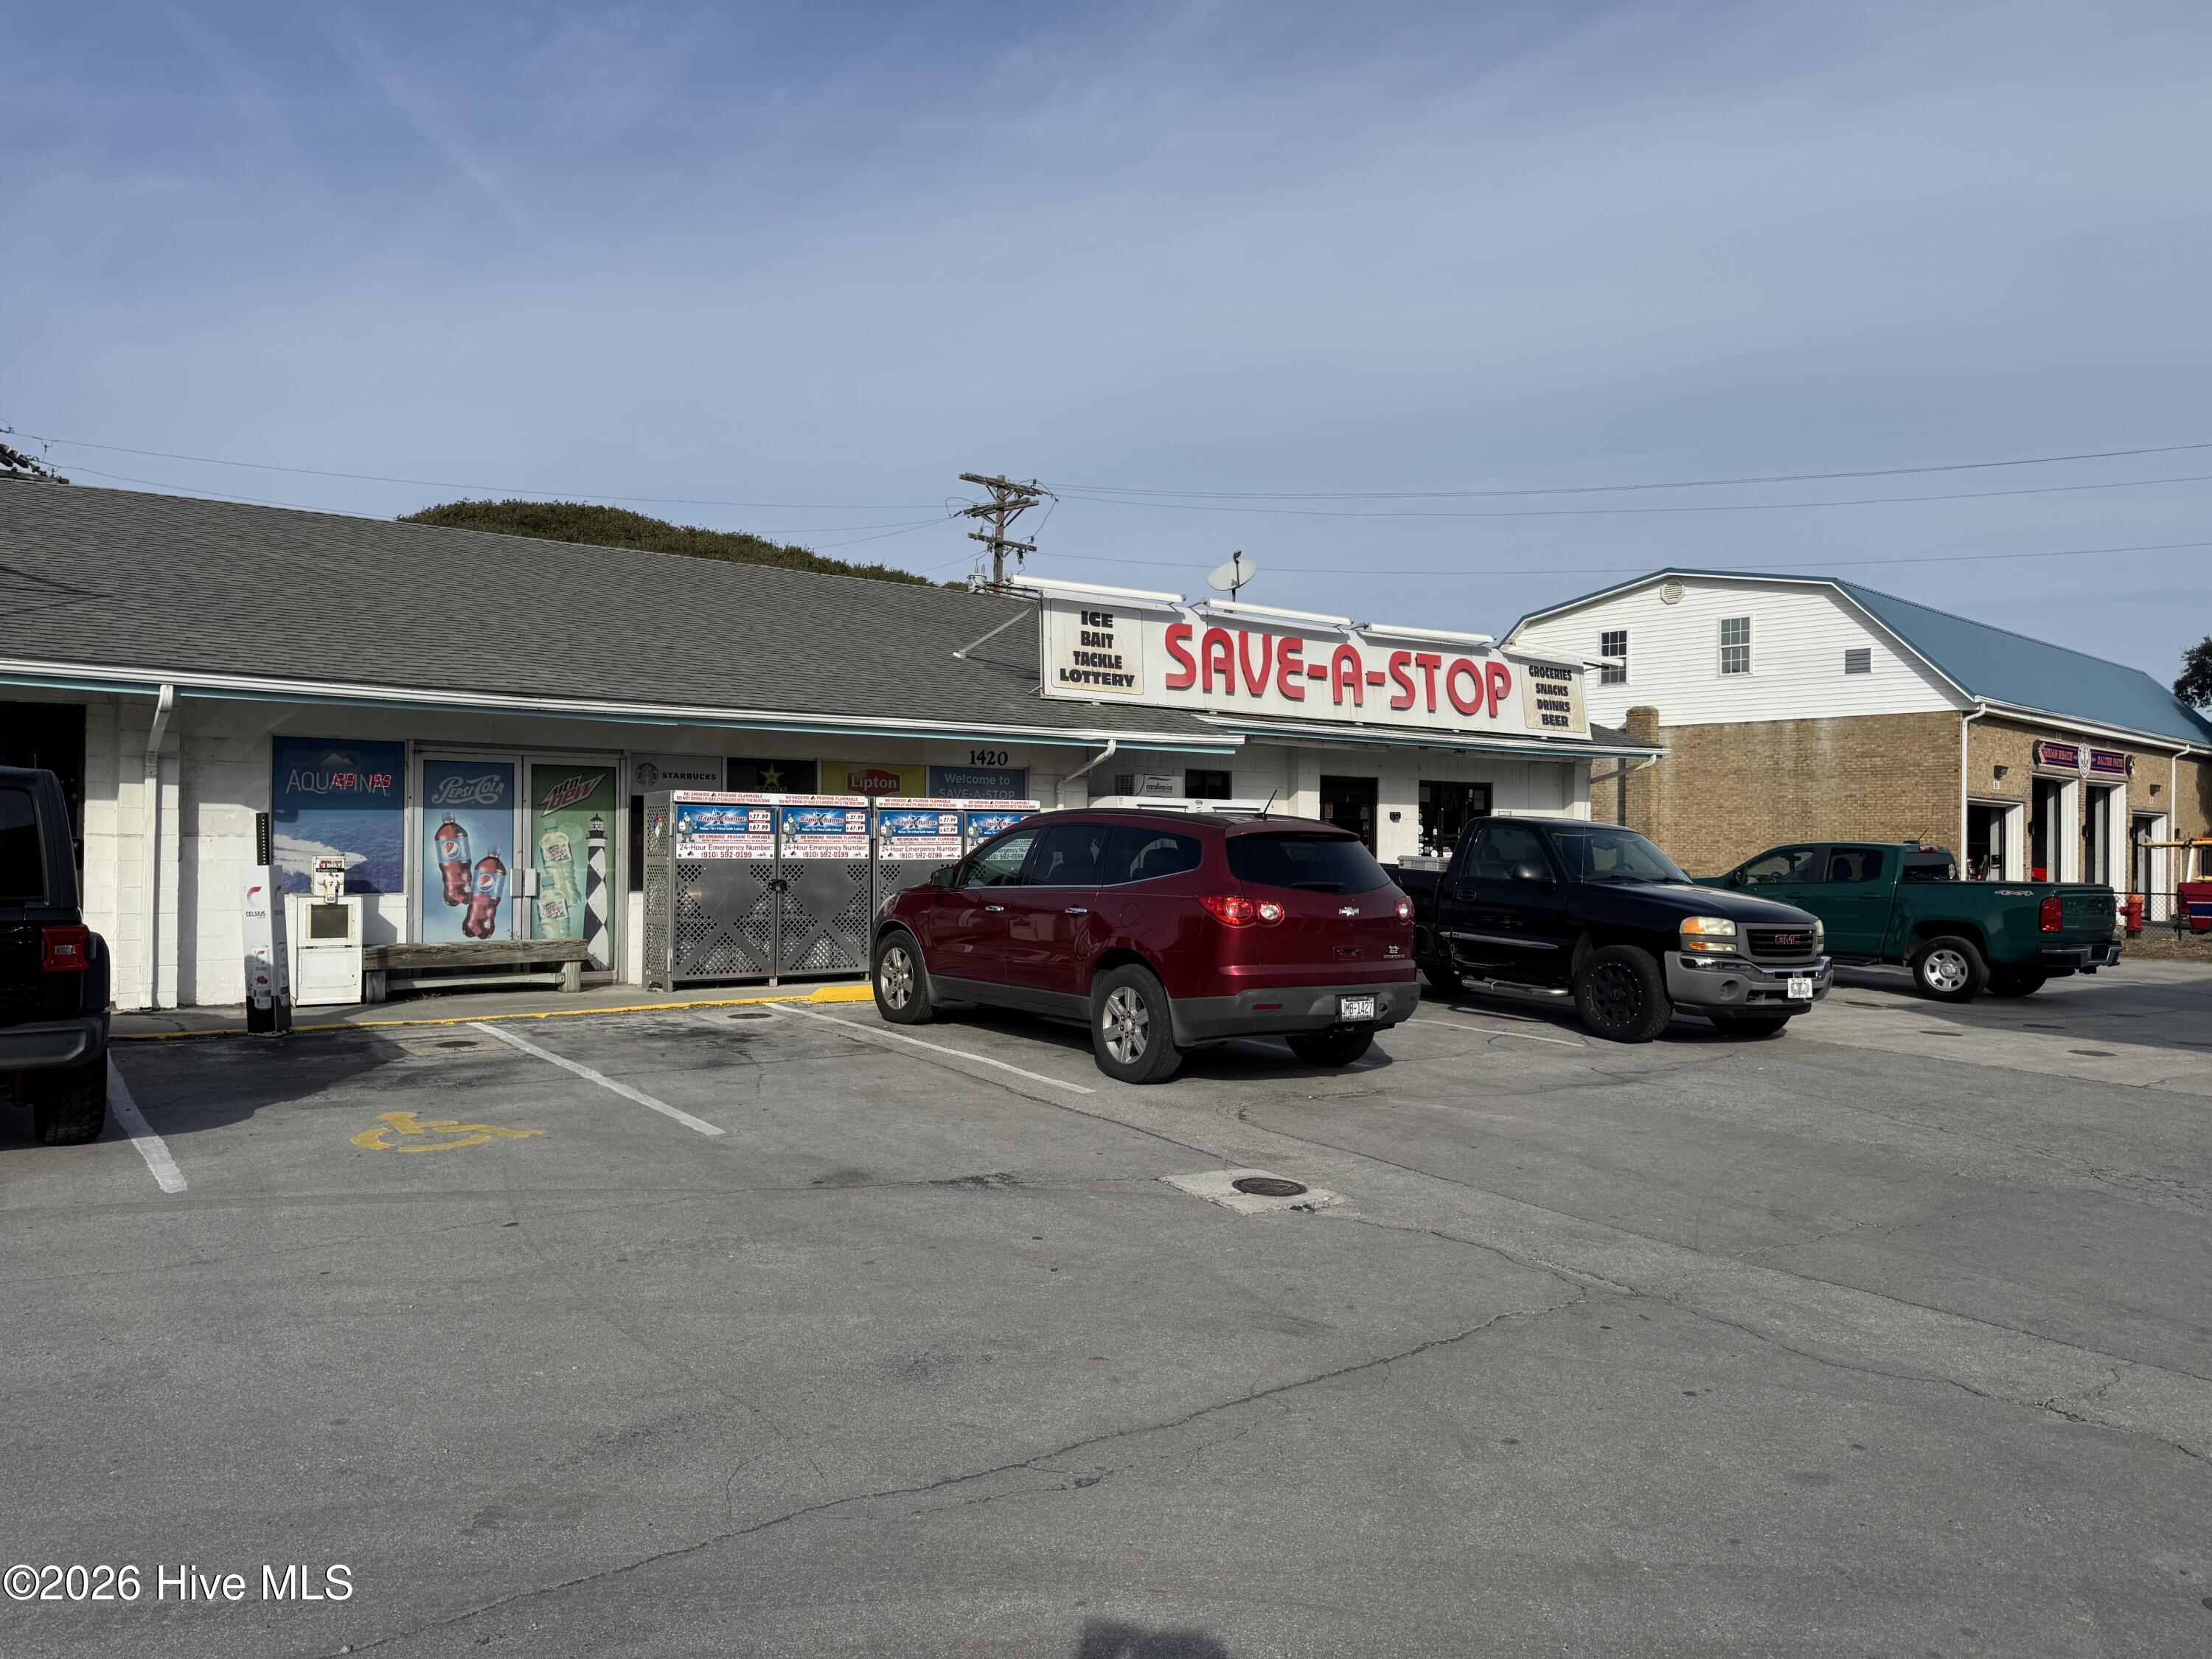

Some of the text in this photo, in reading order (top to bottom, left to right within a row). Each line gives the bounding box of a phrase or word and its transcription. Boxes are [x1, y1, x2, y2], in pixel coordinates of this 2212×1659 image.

[1081, 611, 1113, 628] ICE
[1080, 630, 1113, 649] BAIT
[1073, 651, 1122, 669] TACKLE
[1164, 623, 1512, 717] SAVE-A-STOP
[1528, 665, 1572, 681] GROCERIES
[1060, 668, 1135, 687] LOTTERY
[1535, 683, 1569, 697] SNACKS
[1537, 698, 1571, 712] DRINKS
[1541, 714, 1569, 727] BEER
[970, 750, 1009, 765] 1420
[661, 772, 717, 780] STARBUCKS
[851, 775, 897, 790] Lipton
[944, 773, 1010, 785] Welcome to
[939, 788, 1015, 799] SAVE-A-STOP
[709, 844, 745, 852] Emergency
[810, 844, 842, 852] Emergency
[1775, 934, 1801, 945] GMC
[1342, 1001, 1372, 1015] JMB-1427
